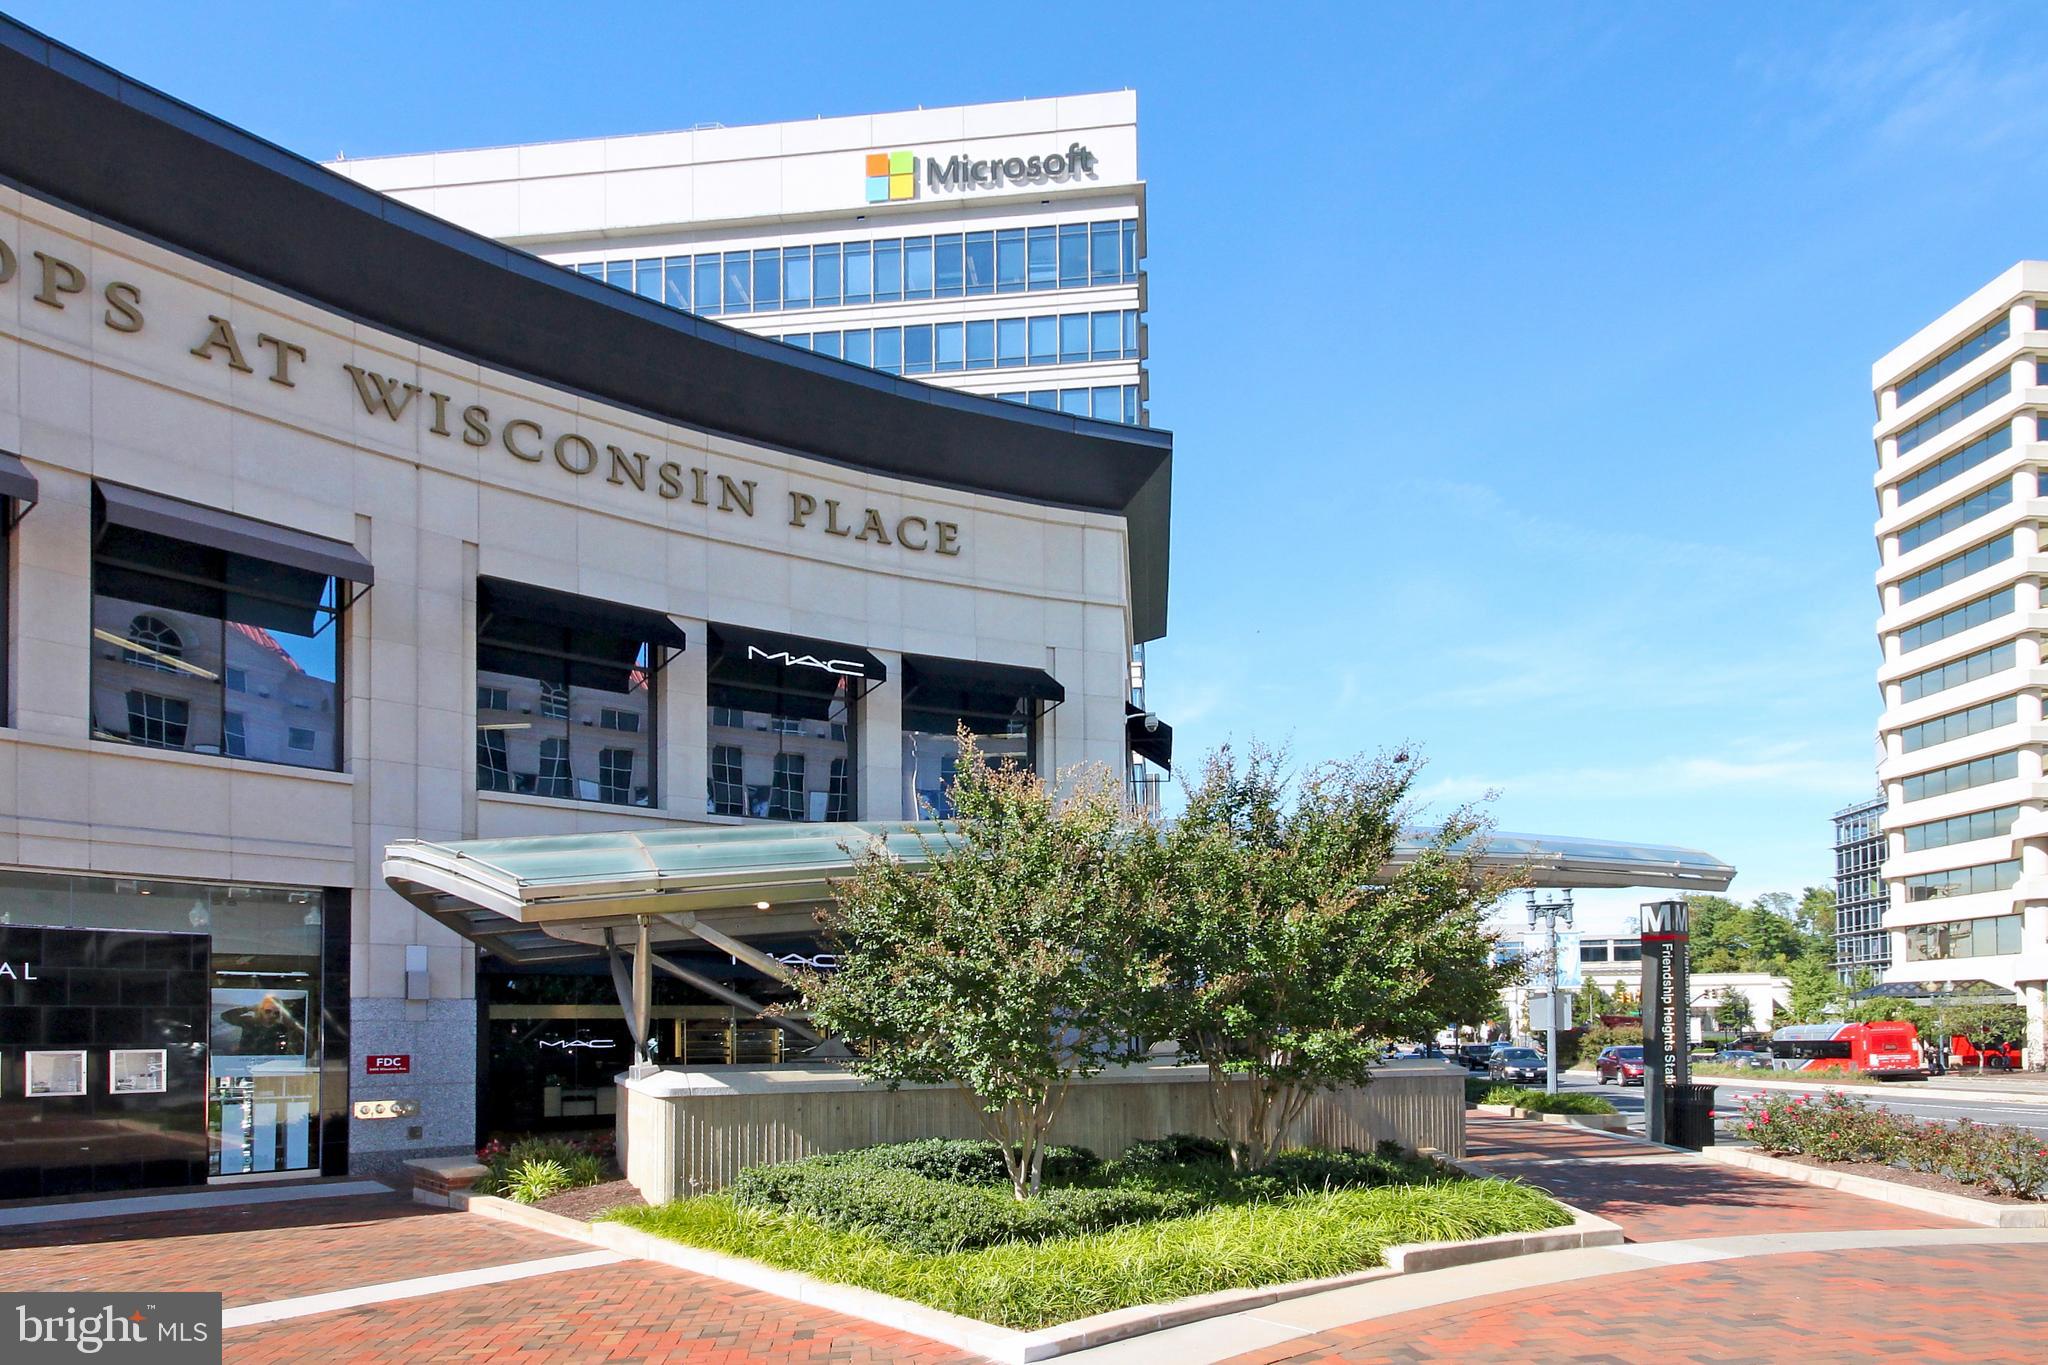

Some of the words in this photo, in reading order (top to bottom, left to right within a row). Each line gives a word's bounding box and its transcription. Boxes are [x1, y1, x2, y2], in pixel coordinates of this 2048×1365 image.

[926, 142, 1092, 186] Microsoft
[0, 238, 144, 333] PS
[190, 314, 307, 388] AT
[343, 363, 758, 518] WISCONSIN
[788, 490, 963, 556] PLACE
[1641, 904, 1672, 933] M
[1661, 943, 1675, 1004] Friendship
[1662, 1007, 1676, 1052] Heights
[376, 1057, 402, 1067] FDC
